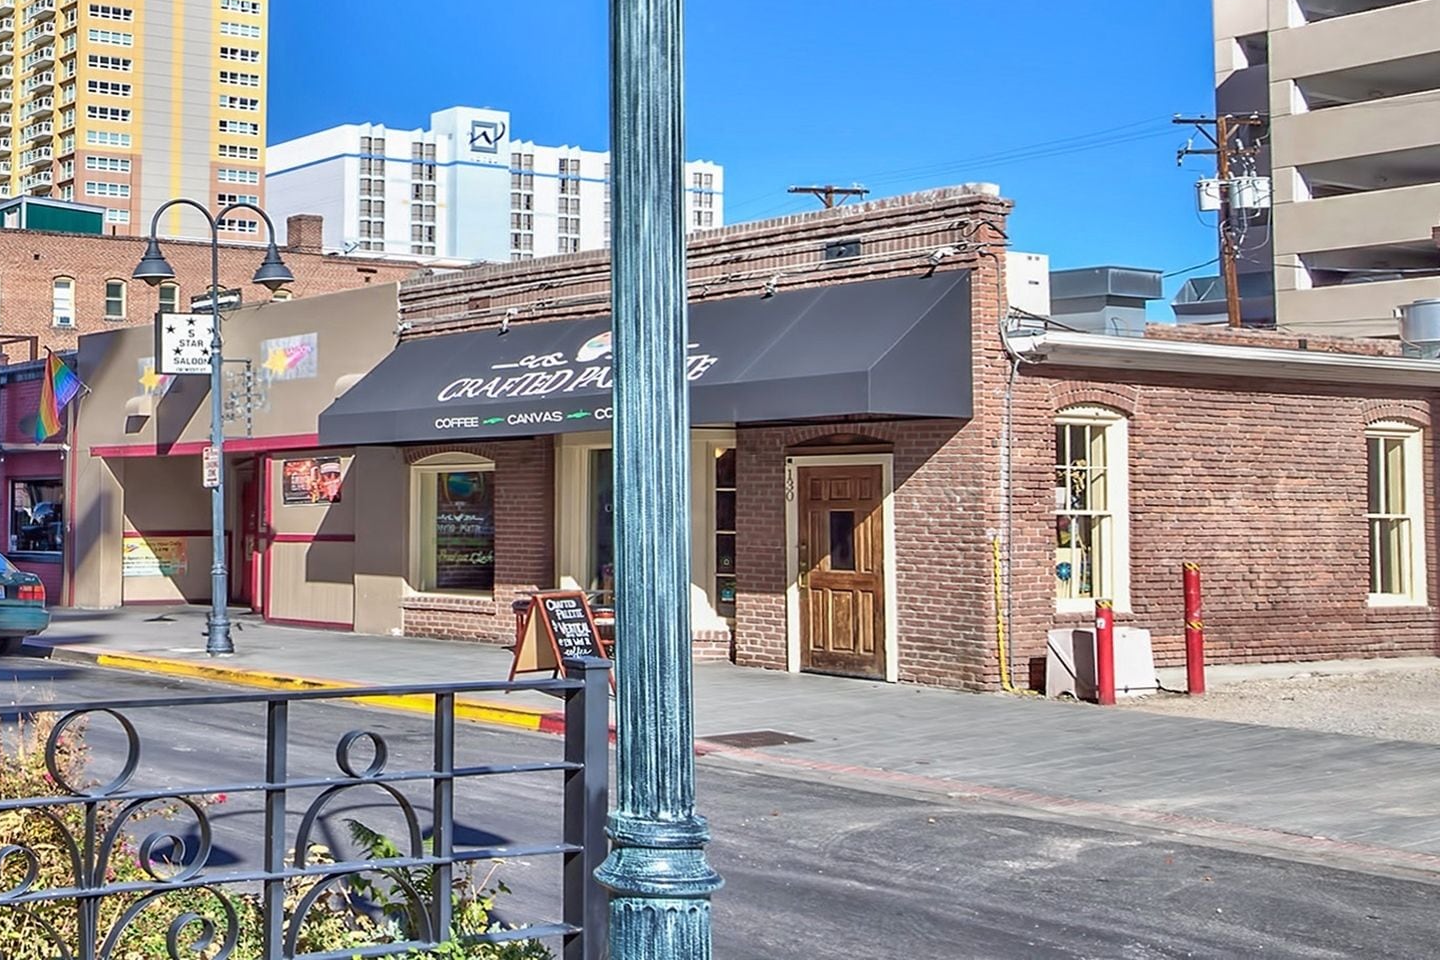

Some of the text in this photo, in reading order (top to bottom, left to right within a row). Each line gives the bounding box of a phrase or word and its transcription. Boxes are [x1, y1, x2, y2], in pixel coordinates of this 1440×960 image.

[179, 339, 204, 347] STAR
[437, 354, 719, 402] CRAFTED PALTE
[435, 416, 479, 429] COFFEE
[507, 410, 563, 425] CANVAS
